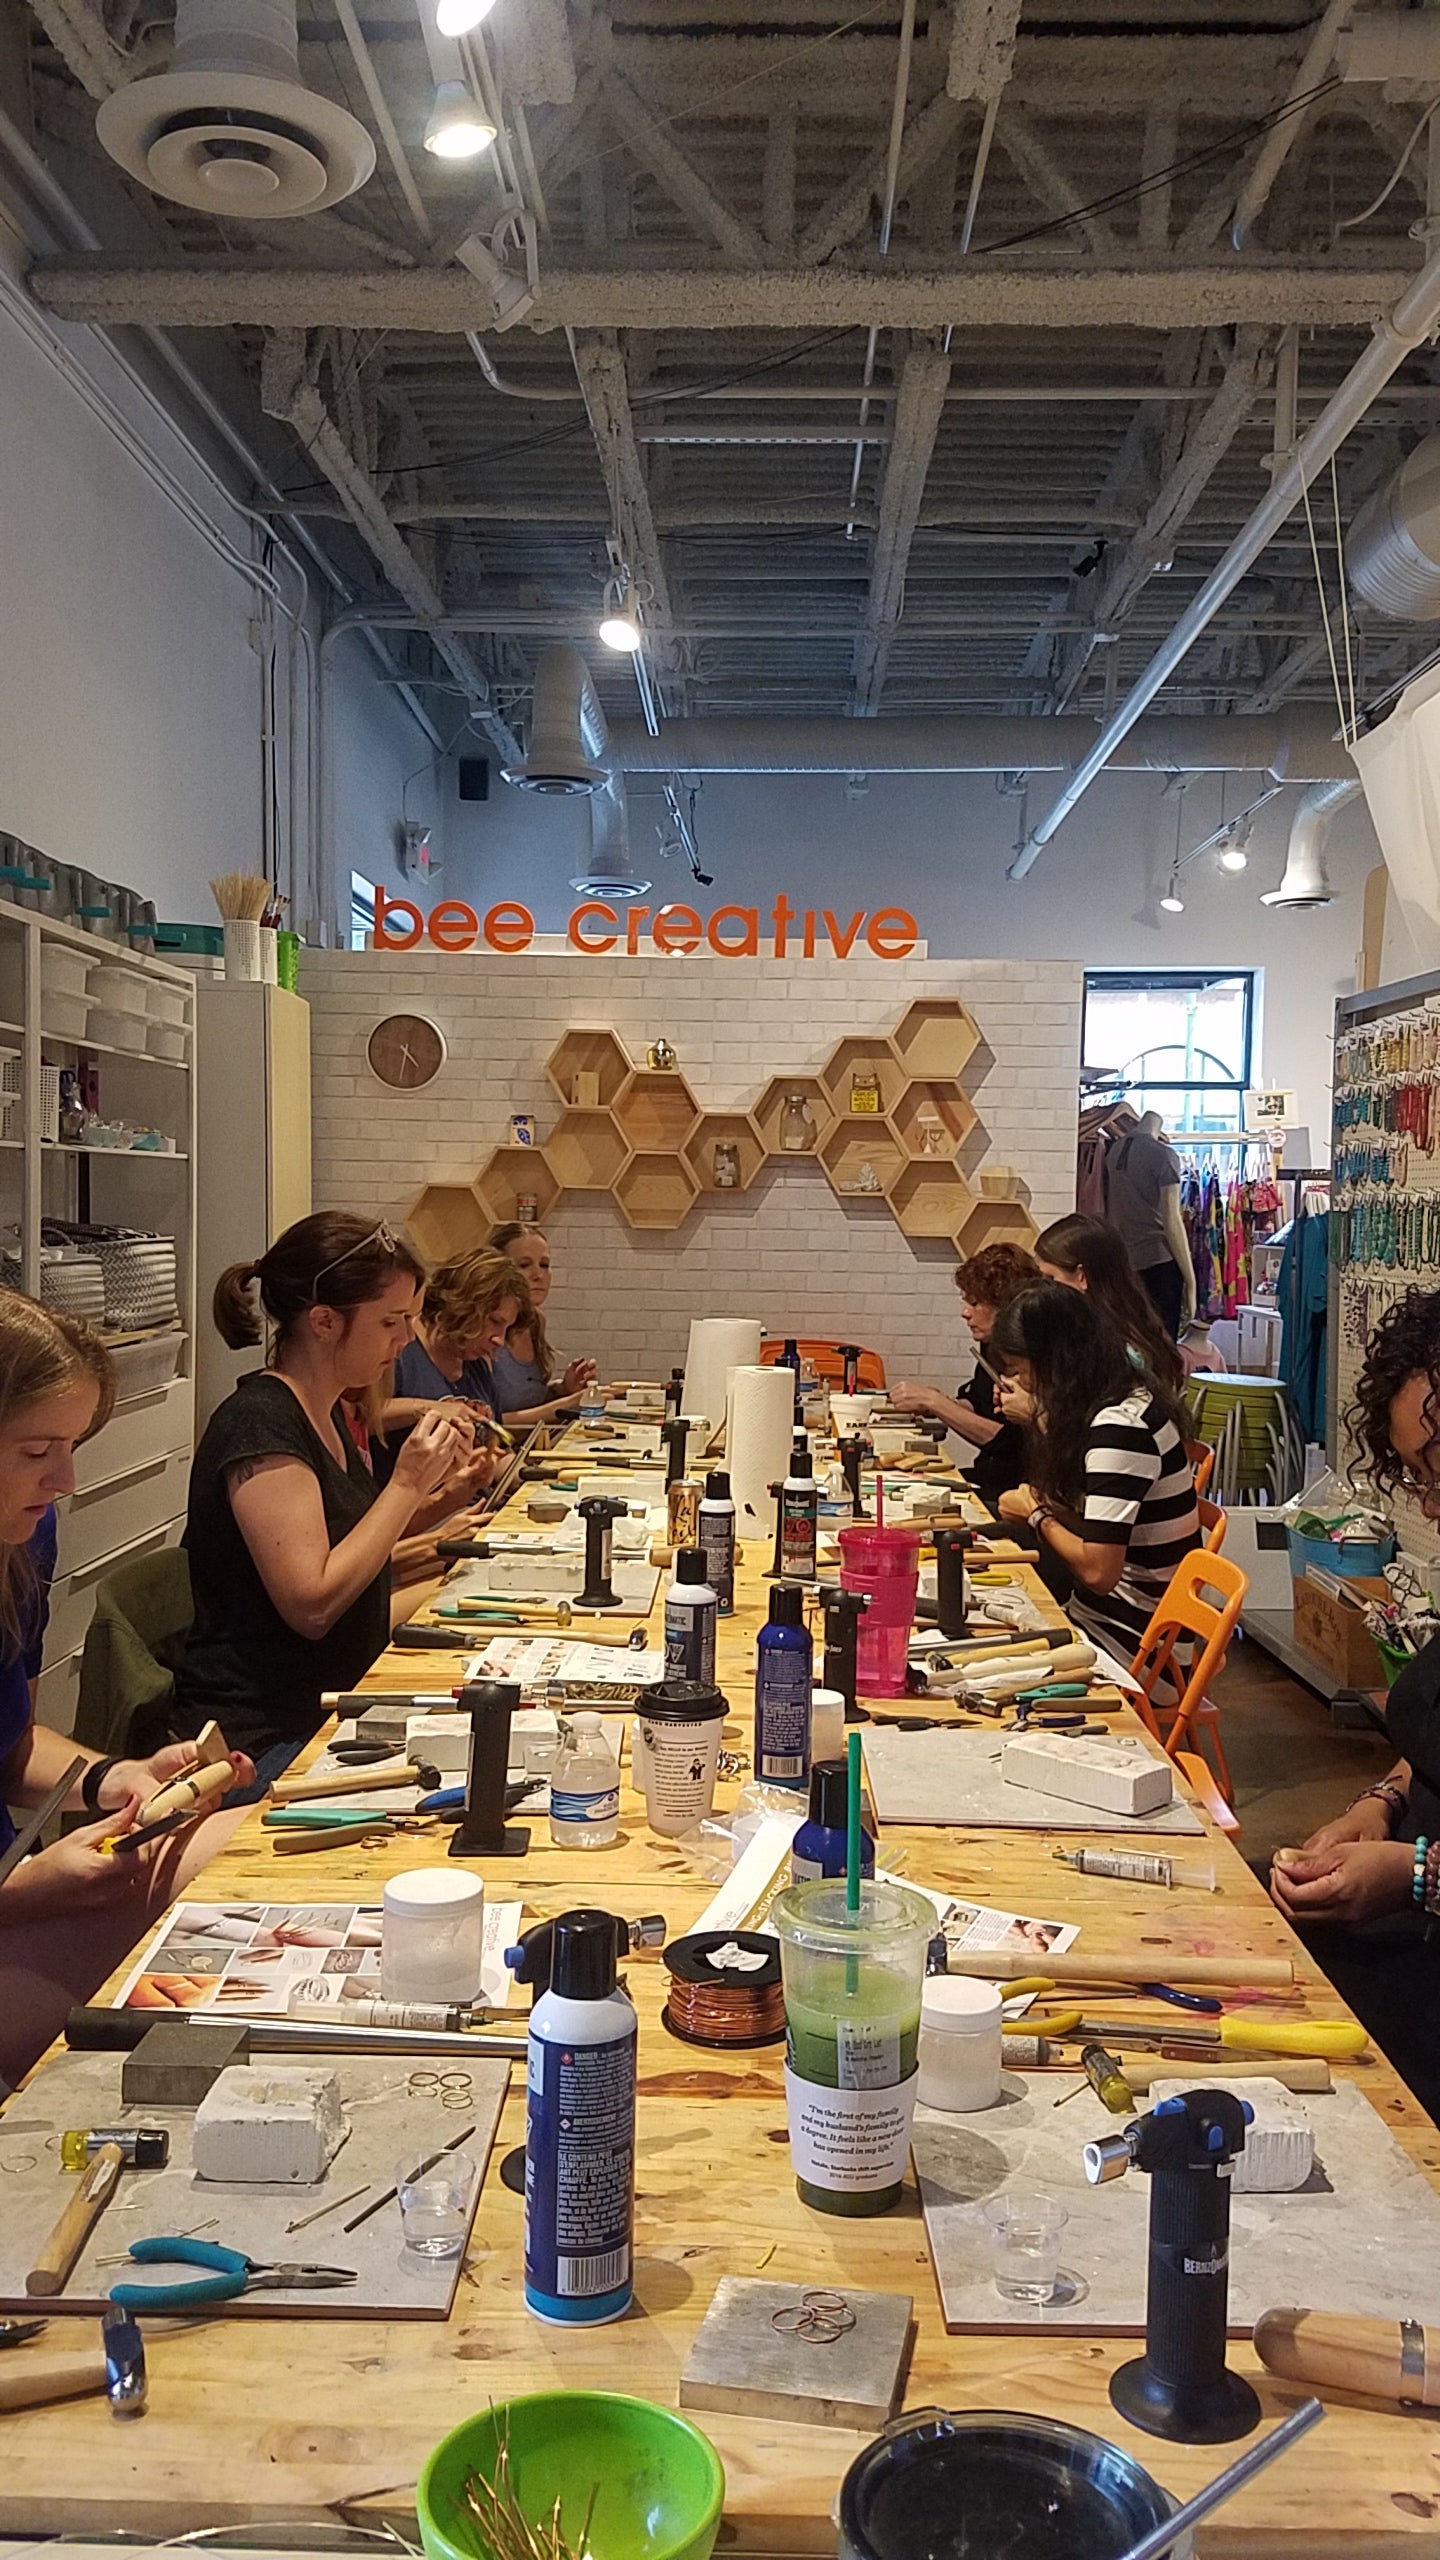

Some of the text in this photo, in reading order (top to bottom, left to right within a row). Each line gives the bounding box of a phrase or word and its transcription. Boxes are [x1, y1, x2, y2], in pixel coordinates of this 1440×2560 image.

[373, 885, 919, 960] bee creative
[824, 2109, 836, 2118] the
[836, 2111, 853, 2120] first
[854, 2112, 864, 2121] of
[876, 2106, 899, 2120] family
[801, 2114, 813, 2123] and
[814, 2119, 824, 2128] my
[825, 2120, 864, 2131] husband's
[864, 2120, 889, 2132] family
[829, 2133, 836, 2141] It
[836, 2135, 855, 2143] feels
[813, 2140, 826, 2151] has
[826, 2146, 855, 2154] opened
